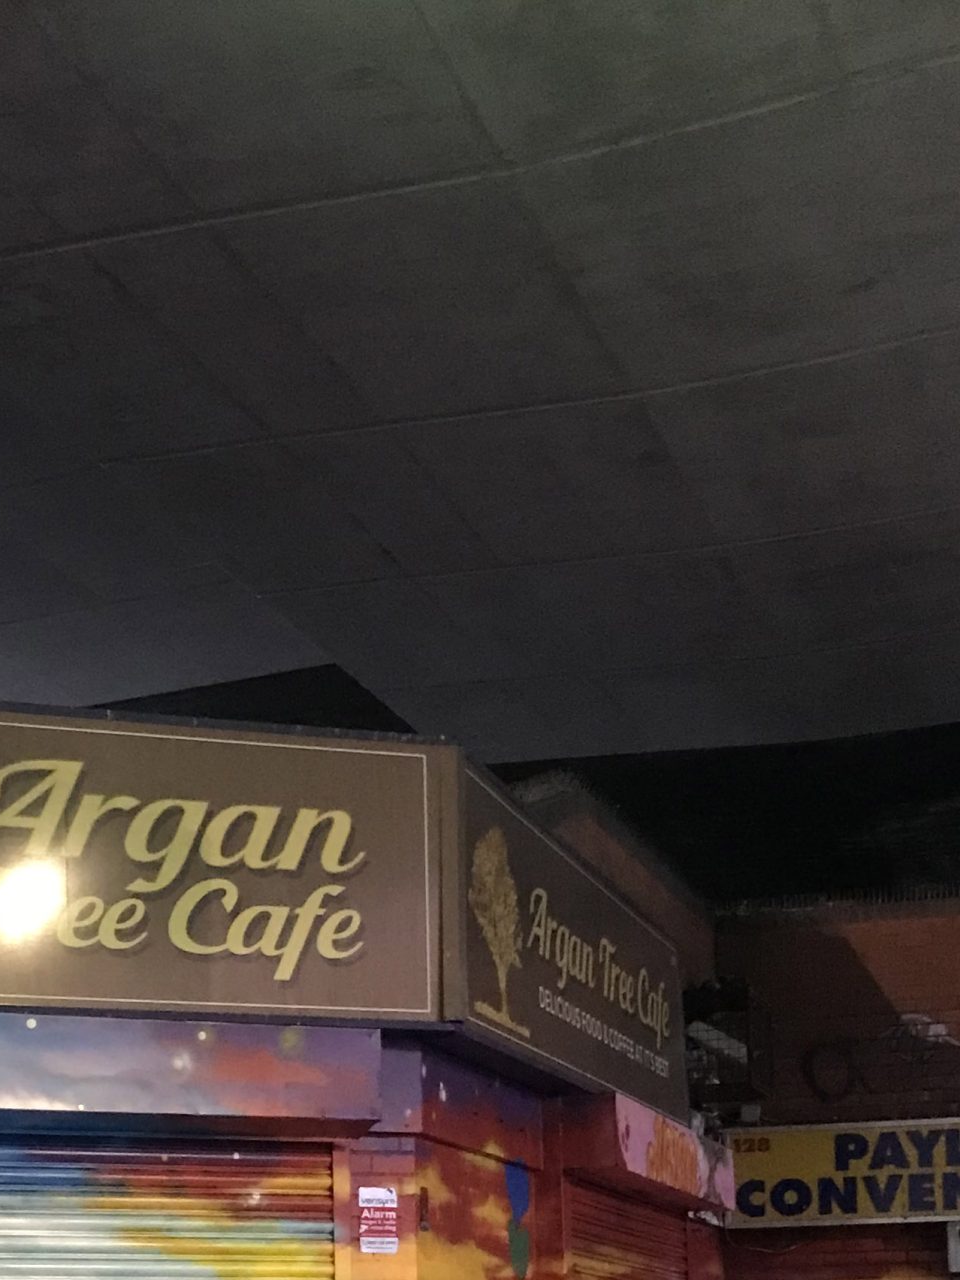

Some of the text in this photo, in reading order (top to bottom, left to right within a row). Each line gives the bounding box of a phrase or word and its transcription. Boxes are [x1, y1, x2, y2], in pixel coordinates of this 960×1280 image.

[168, 878, 365, 982] Cafe
[527, 888, 671, 1050] Argan Tree Cafe
[539, 985, 581, 1029] DELICIOUS
[581, 1011, 602, 1041] FOOD
[609, 1027, 634, 1060] COFFEE
[734, 1137, 771, 1154] 128
[361, 1208, 397, 1219] Alarm
